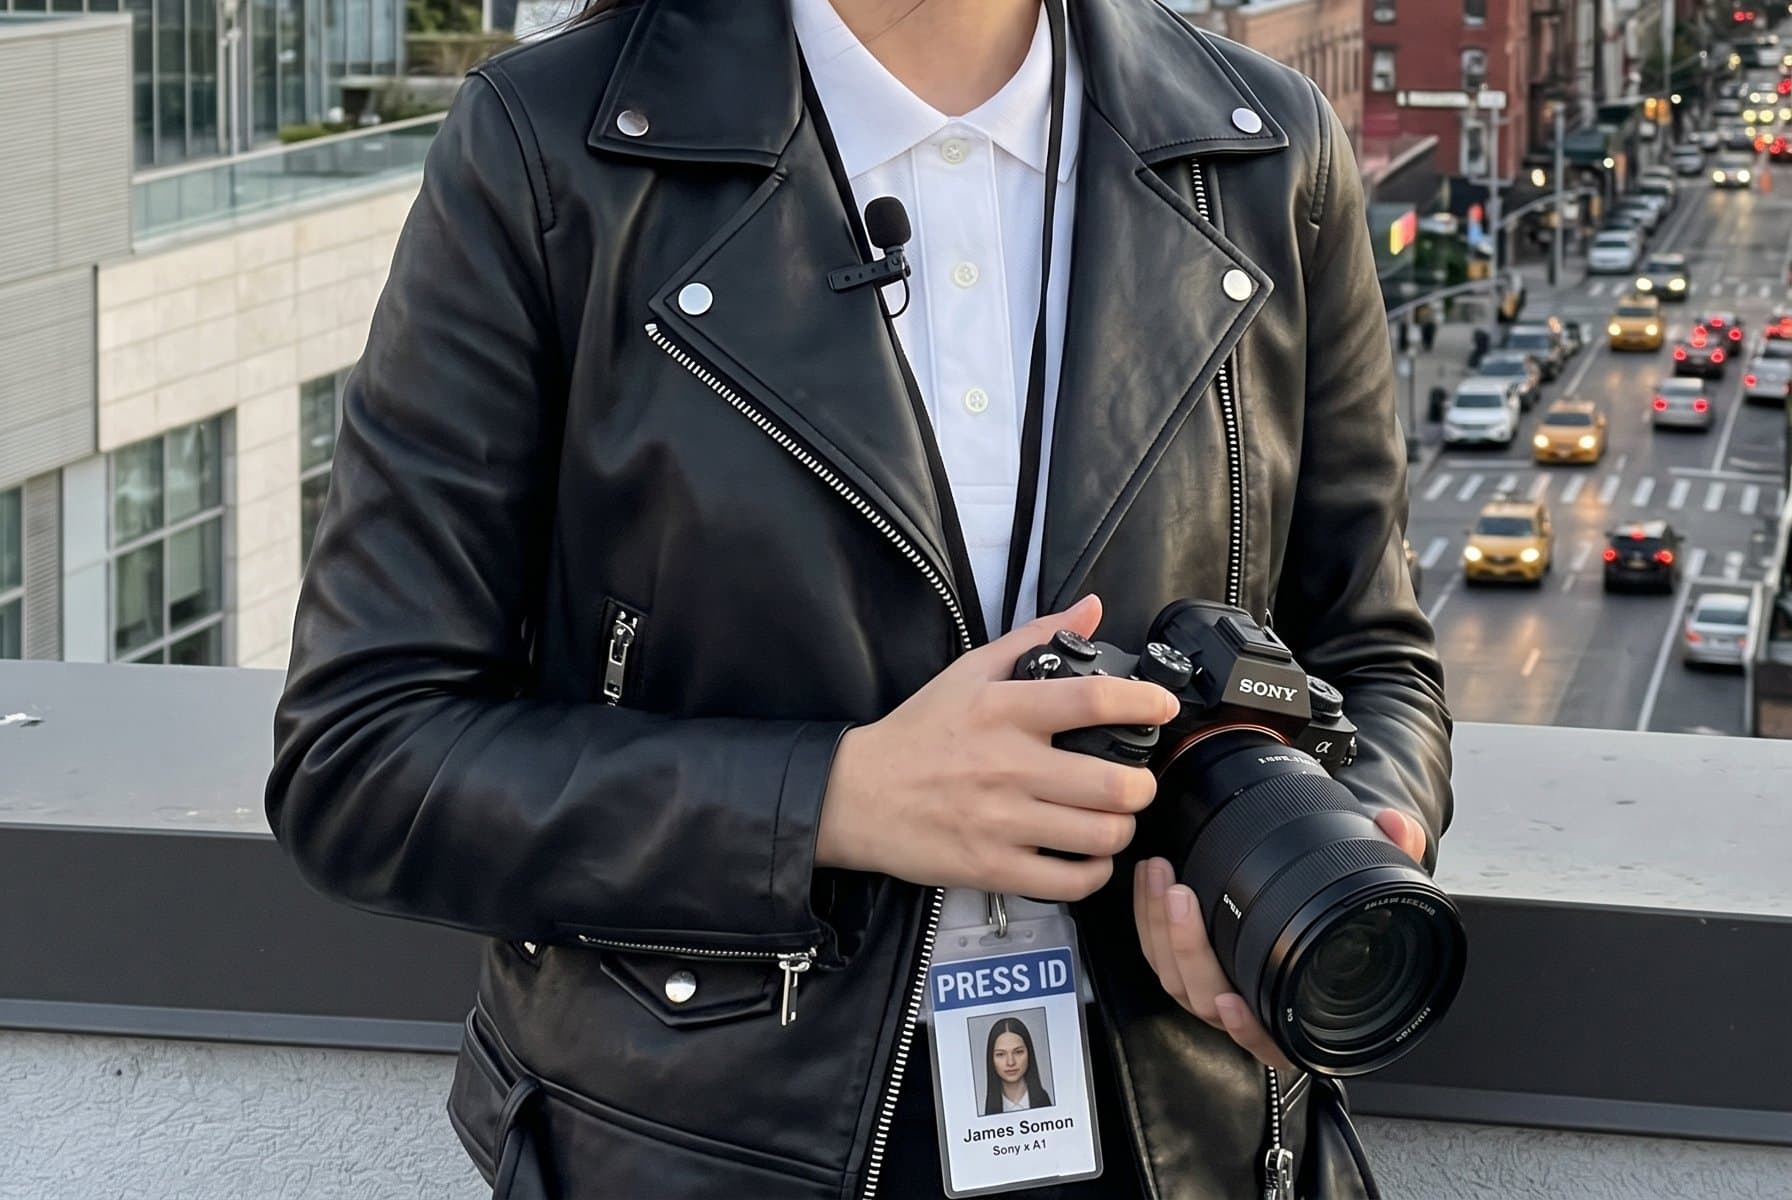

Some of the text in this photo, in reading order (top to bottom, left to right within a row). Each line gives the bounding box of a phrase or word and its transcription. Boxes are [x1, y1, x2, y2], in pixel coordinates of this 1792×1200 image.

[1240, 679, 1298, 701] SONY
[938, 960, 1067, 1002] PRESS ID
[964, 1117, 1074, 1142] James Somon
[993, 1145, 1020, 1156] Sony
[1033, 1139, 1046, 1150] A1
